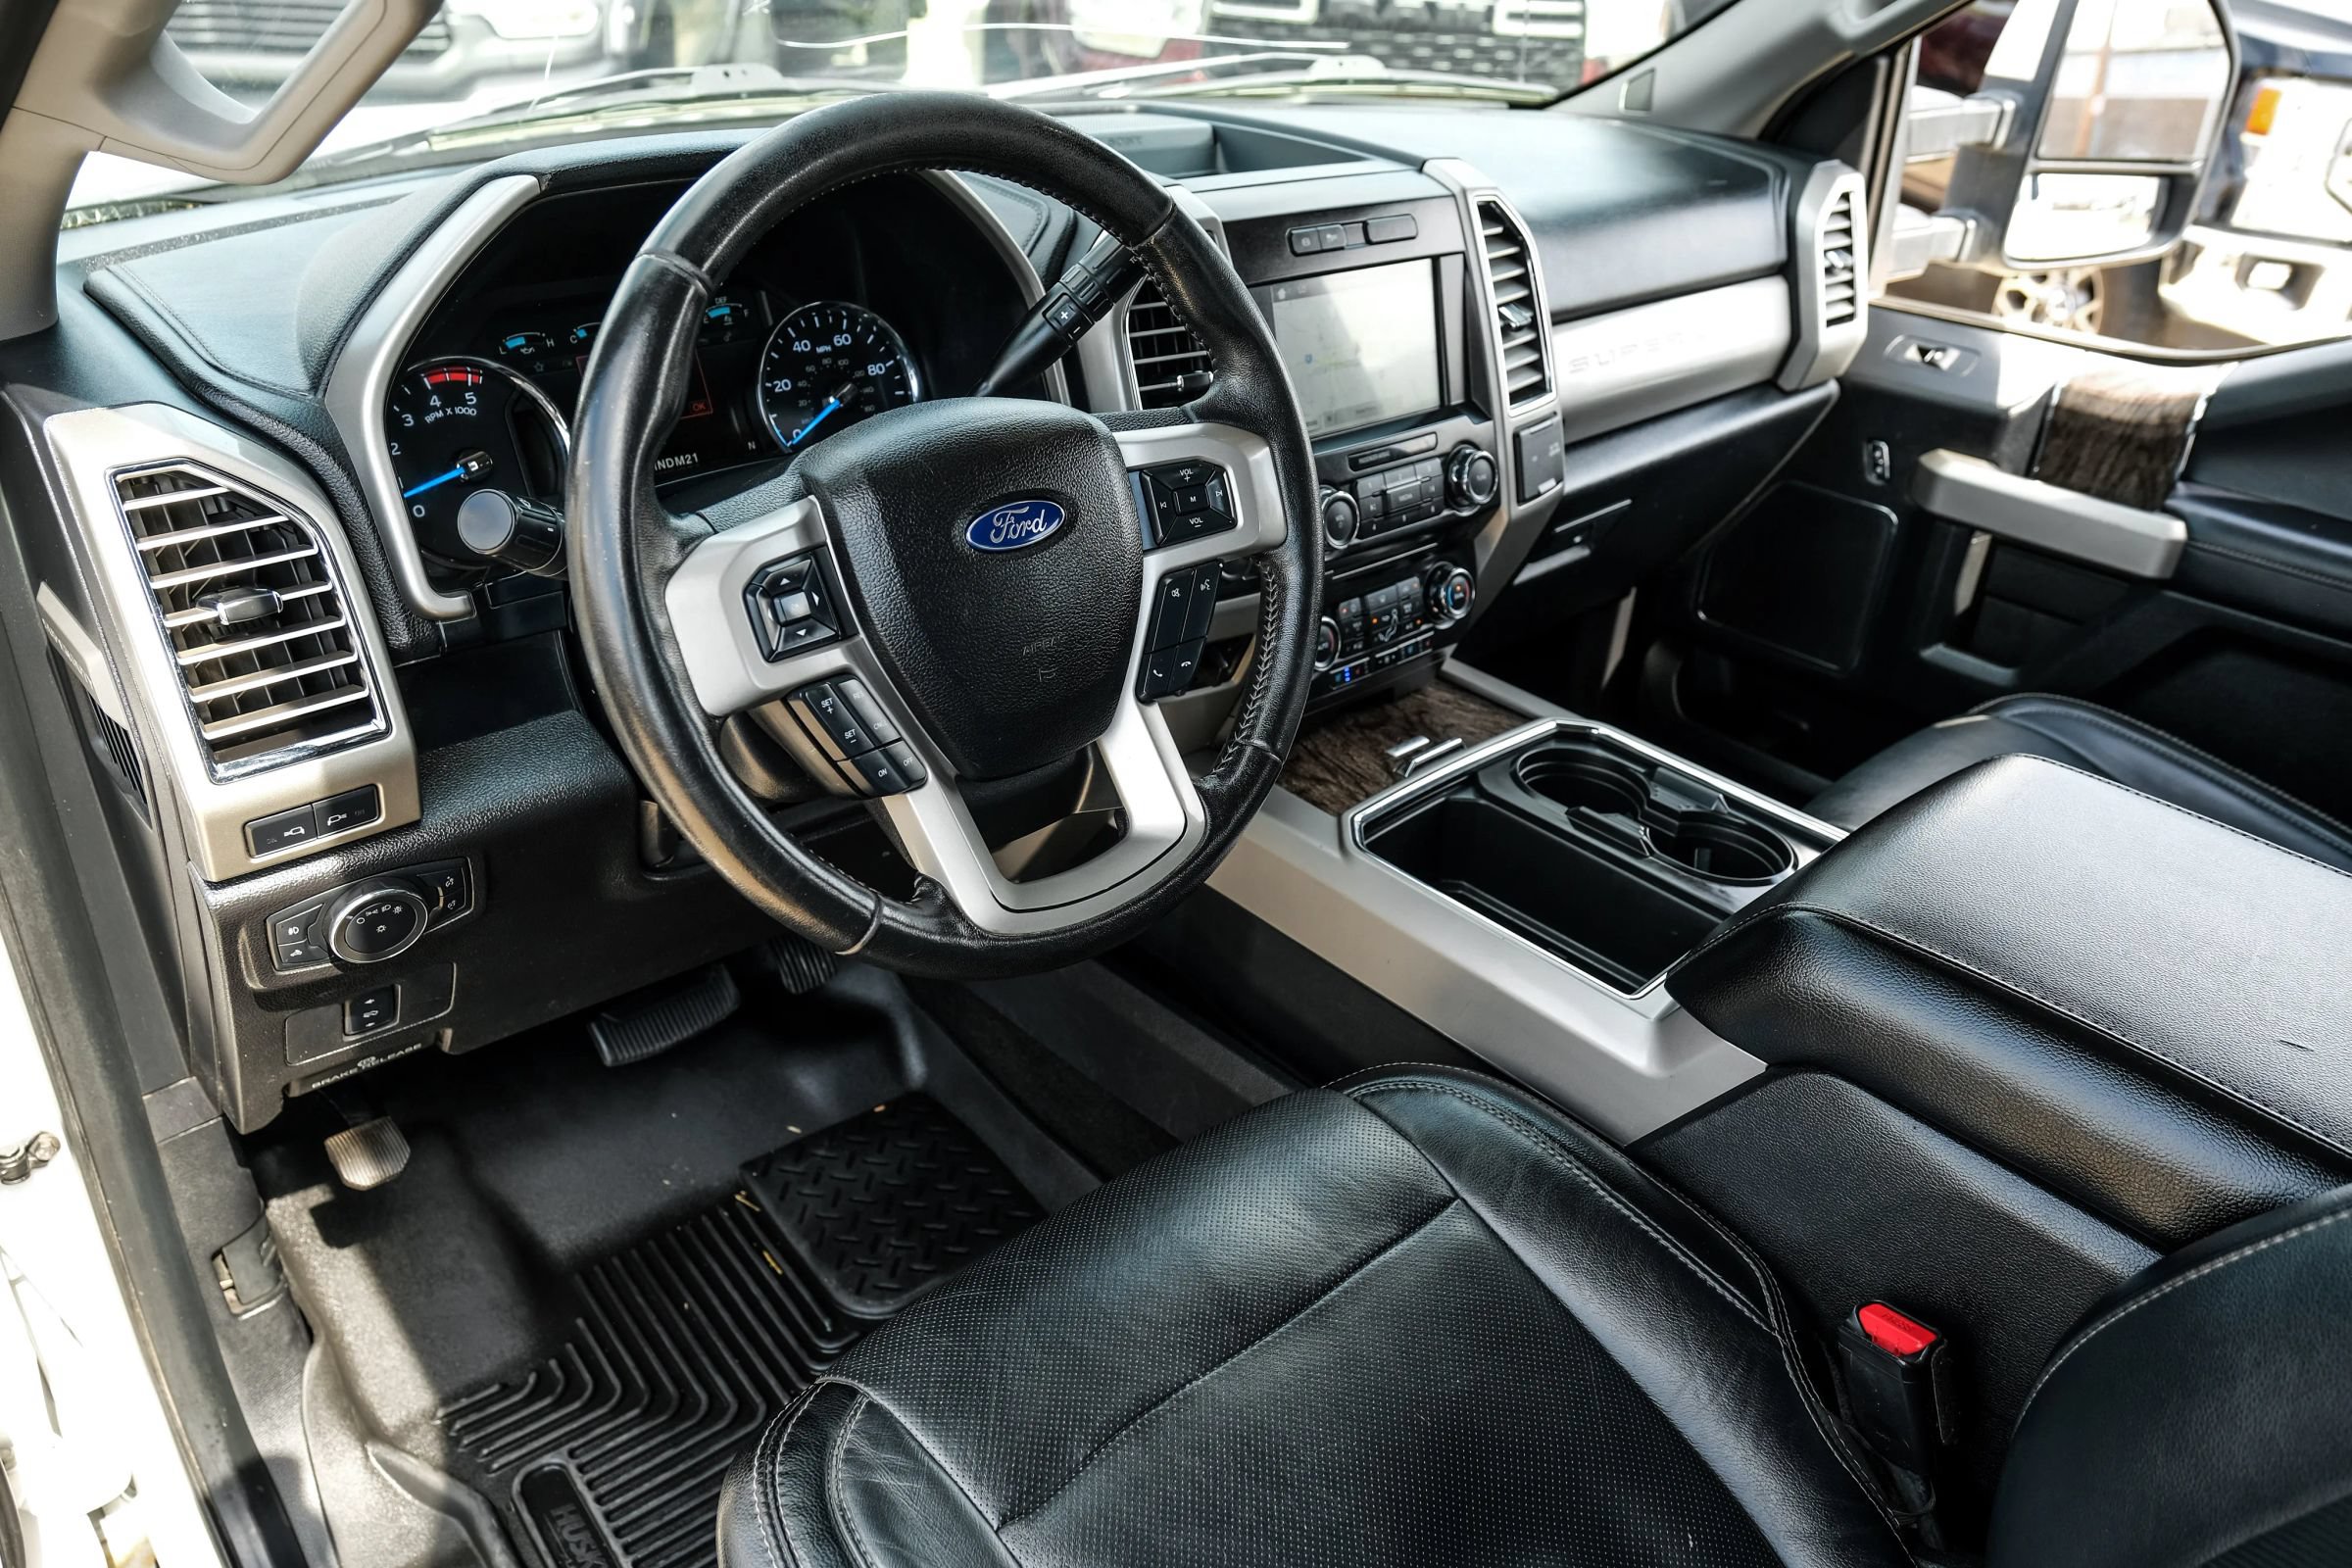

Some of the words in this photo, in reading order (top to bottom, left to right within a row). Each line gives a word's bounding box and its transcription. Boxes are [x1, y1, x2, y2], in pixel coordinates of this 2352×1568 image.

[546, 338, 555, 348] H
[569, 334, 578, 344] C
[833, 333, 852, 347] 60
[499, 346, 507, 355] L
[793, 339, 811, 353] 40
[815, 344, 832, 353] MPH
[867, 363, 886, 376] 80
[772, 378, 792, 393] 20
[429, 394, 442, 408] 4
[465, 392, 477, 405] 5
[692, 402, 707, 412] OK
[402, 414, 415, 427] 3
[424, 410, 444, 424] RPM
[445, 407, 453, 416] X
[455, 406, 477, 416] 1000
[390, 442, 402, 456] 2
[748, 440, 757, 450] N
[1179, 467, 1194, 476] VOL
[412, 505, 425, 518] 0
[989, 506, 1048, 544] Ford
[1189, 516, 1203, 525] VOL
[821, 698, 833, 708] SET
[845, 729, 856, 739] SET
[904, 757, 913, 765] OFF
[878, 768, 887, 777] ON
[311, 1067, 359, 1089] BRAKE
[361, 1043, 422, 1070] RELEASE
